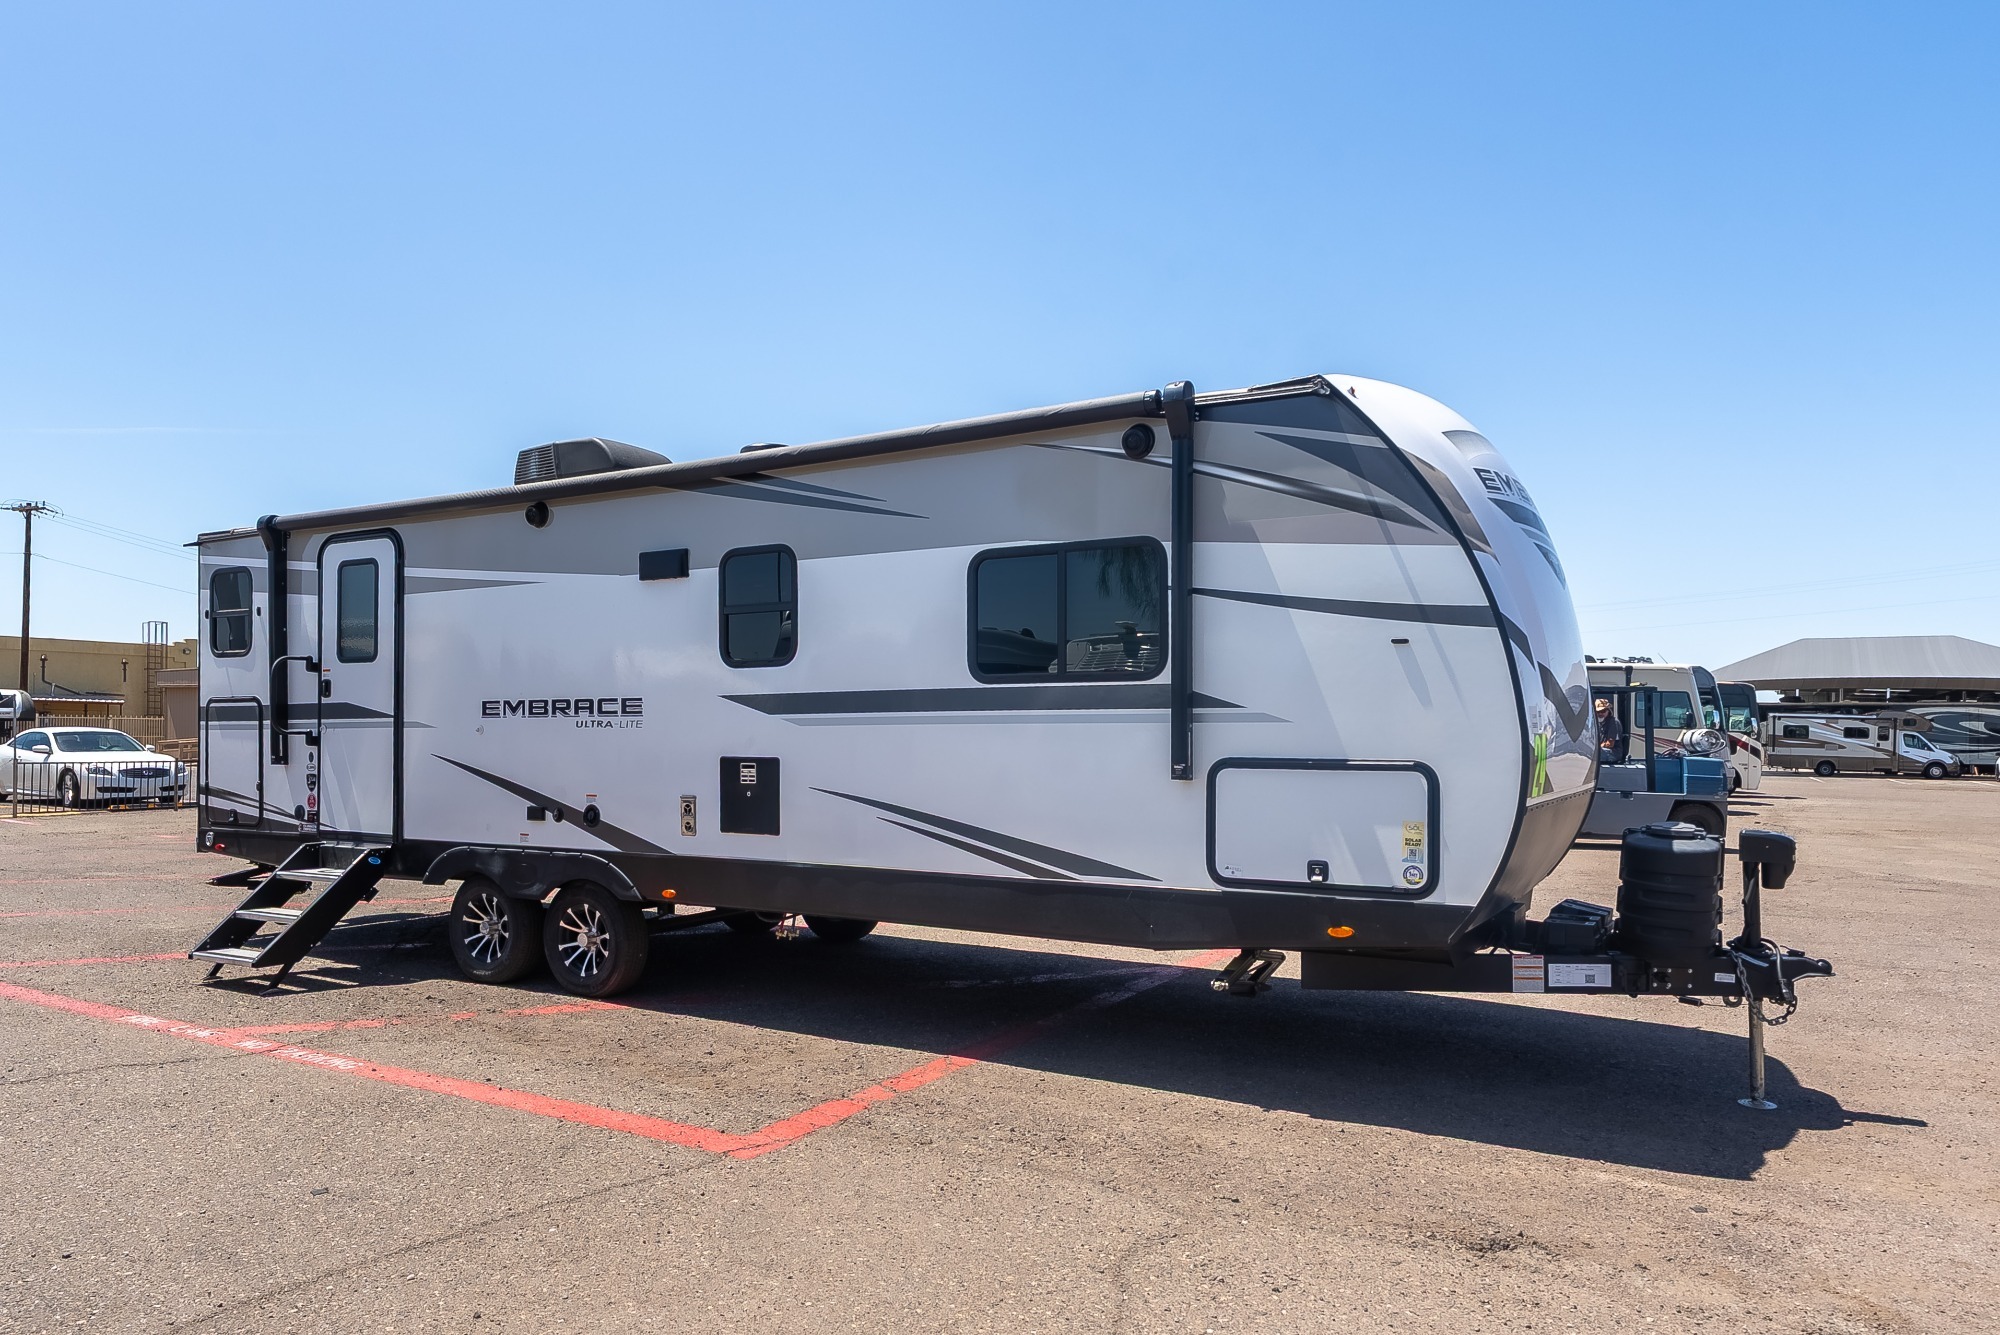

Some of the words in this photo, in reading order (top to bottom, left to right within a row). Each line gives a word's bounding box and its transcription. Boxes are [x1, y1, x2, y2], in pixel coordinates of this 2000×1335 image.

[1472, 467, 1533, 507] EMB
[481, 697, 644, 718] EMBRACE
[575, 719, 644, 729] ULTRA-LITE
